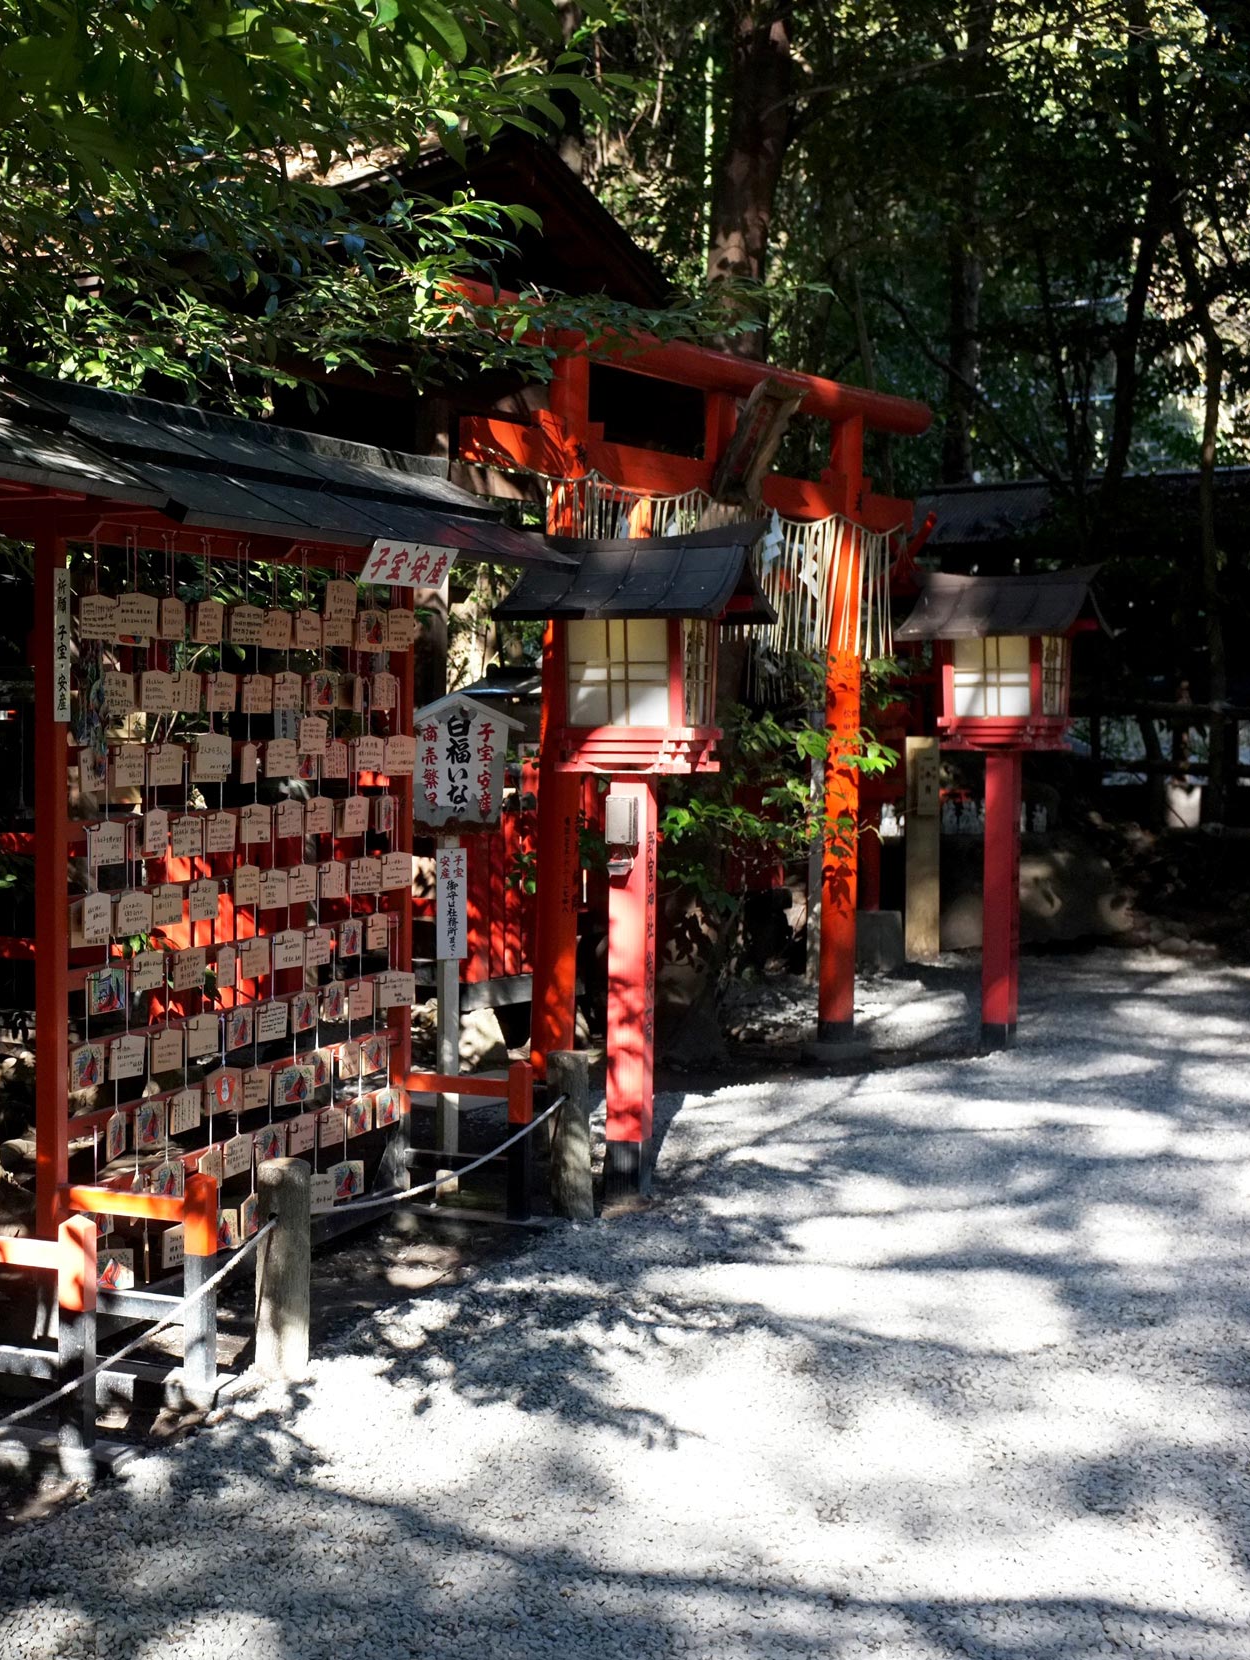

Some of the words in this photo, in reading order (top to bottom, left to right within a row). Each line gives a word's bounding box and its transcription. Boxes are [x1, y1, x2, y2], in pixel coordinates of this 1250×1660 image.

[370, 547, 447, 585] 子宝・安産
